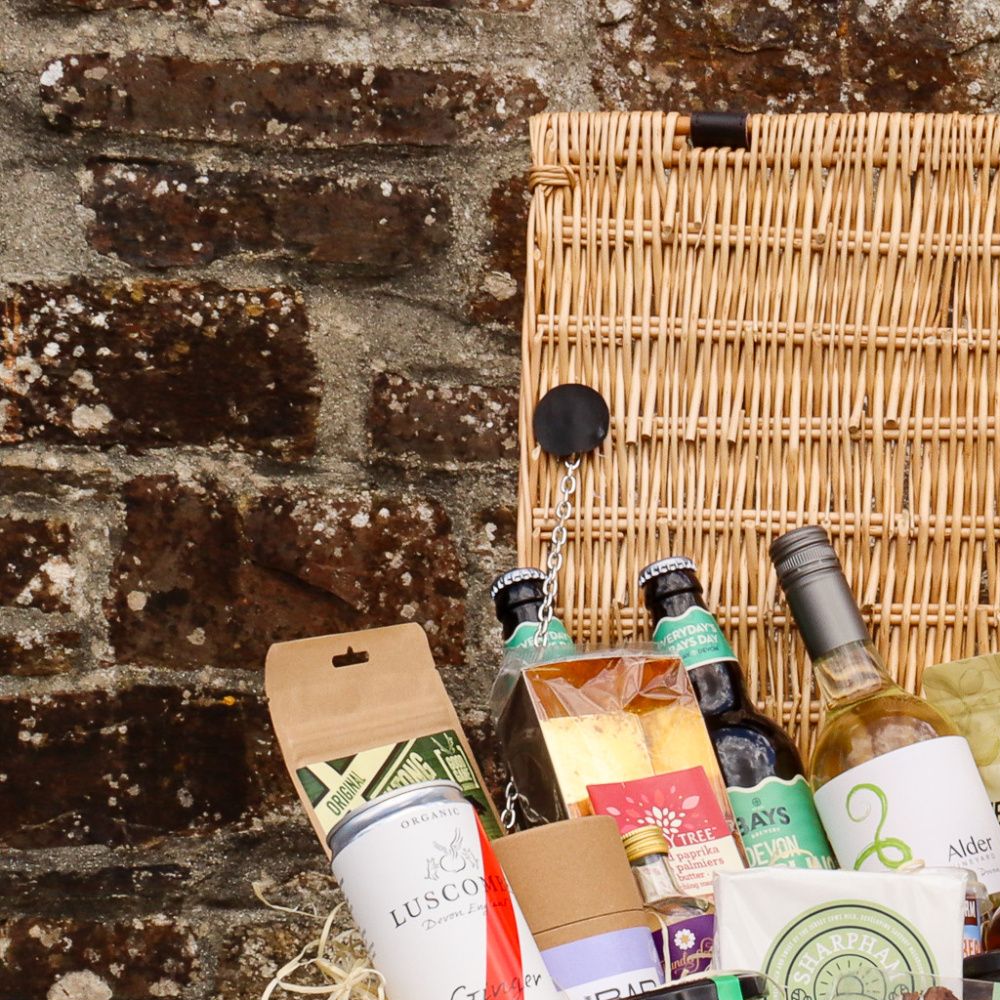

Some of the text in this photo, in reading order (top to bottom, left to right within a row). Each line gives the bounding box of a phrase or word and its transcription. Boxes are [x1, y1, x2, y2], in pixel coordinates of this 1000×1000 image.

[697, 634, 718, 645] DAY
[326, 770, 366, 816] ORIGINAL
[401, 807, 460, 829] ORGANIC
[678, 828, 715, 845] TREE
[677, 845, 720, 863] paprika
[948, 836, 992, 862] Alder
[677, 858, 725, 874] palmiers
[793, 932, 904, 985] SHARPHAM
